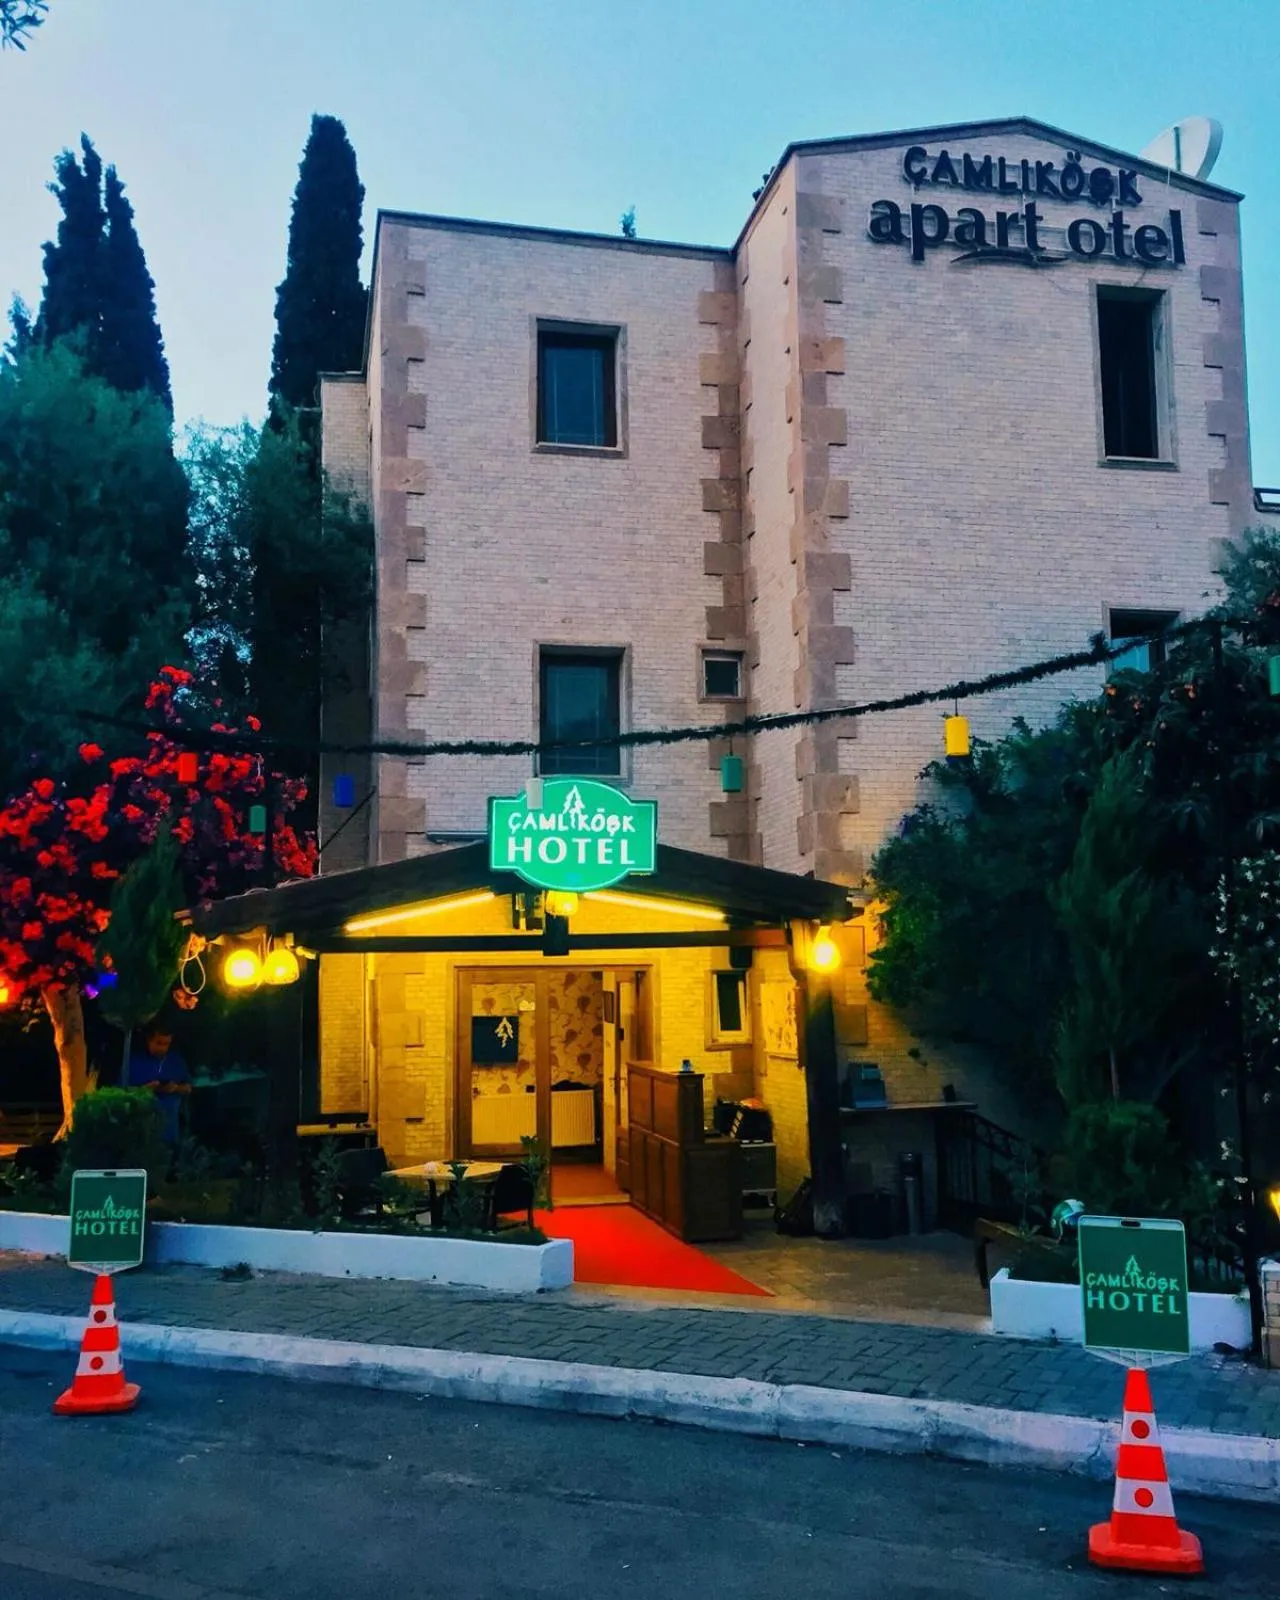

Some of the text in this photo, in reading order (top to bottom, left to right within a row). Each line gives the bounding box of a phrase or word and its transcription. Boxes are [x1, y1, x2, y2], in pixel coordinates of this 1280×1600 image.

[867, 199, 1187, 265] apart otel
[507, 836, 636, 866] HOTEL
[74, 1221, 140, 1236] HOTEL
[1086, 1289, 1181, 1315] HOTEL
